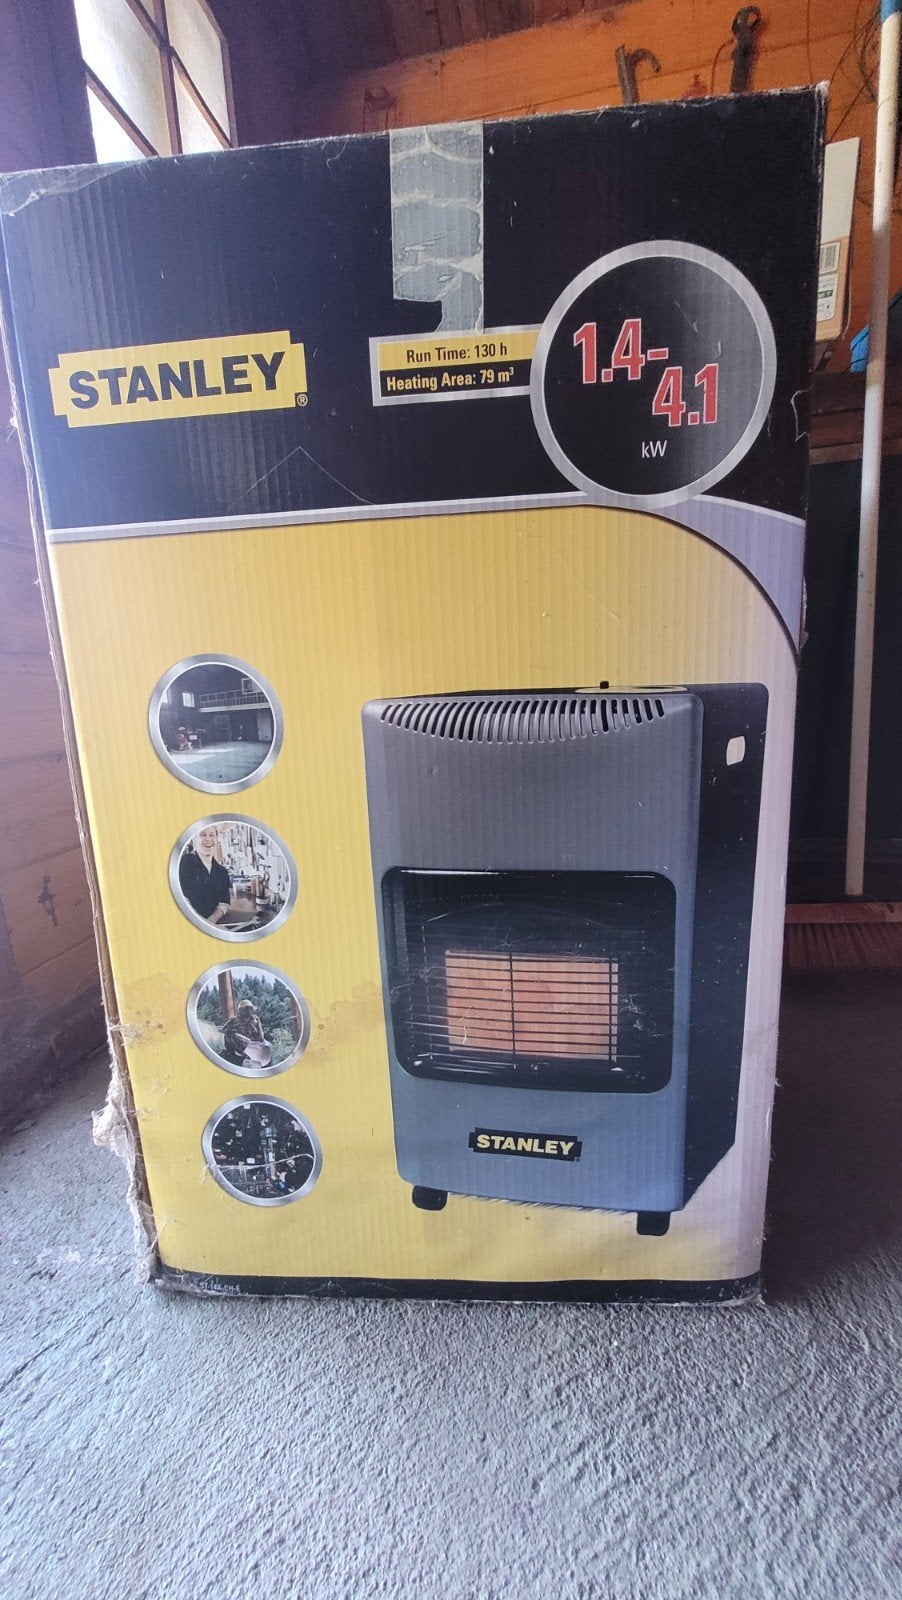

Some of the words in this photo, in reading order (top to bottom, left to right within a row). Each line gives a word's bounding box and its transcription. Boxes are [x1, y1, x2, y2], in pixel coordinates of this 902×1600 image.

[406, 349, 431, 363] Run
[435, 346, 470, 361] Time:
[474, 343, 495, 358] 130
[500, 342, 507, 356] h
[69, 351, 285, 410] STANLEY
[386, 374, 438, 391] Heating
[441, 372, 476, 387] Area:
[479, 369, 494, 384] 79
[652, 363, 719, 427] 4.1
[641, 440, 667, 458] kW
[476, 1134, 575, 1155] STANLEY
